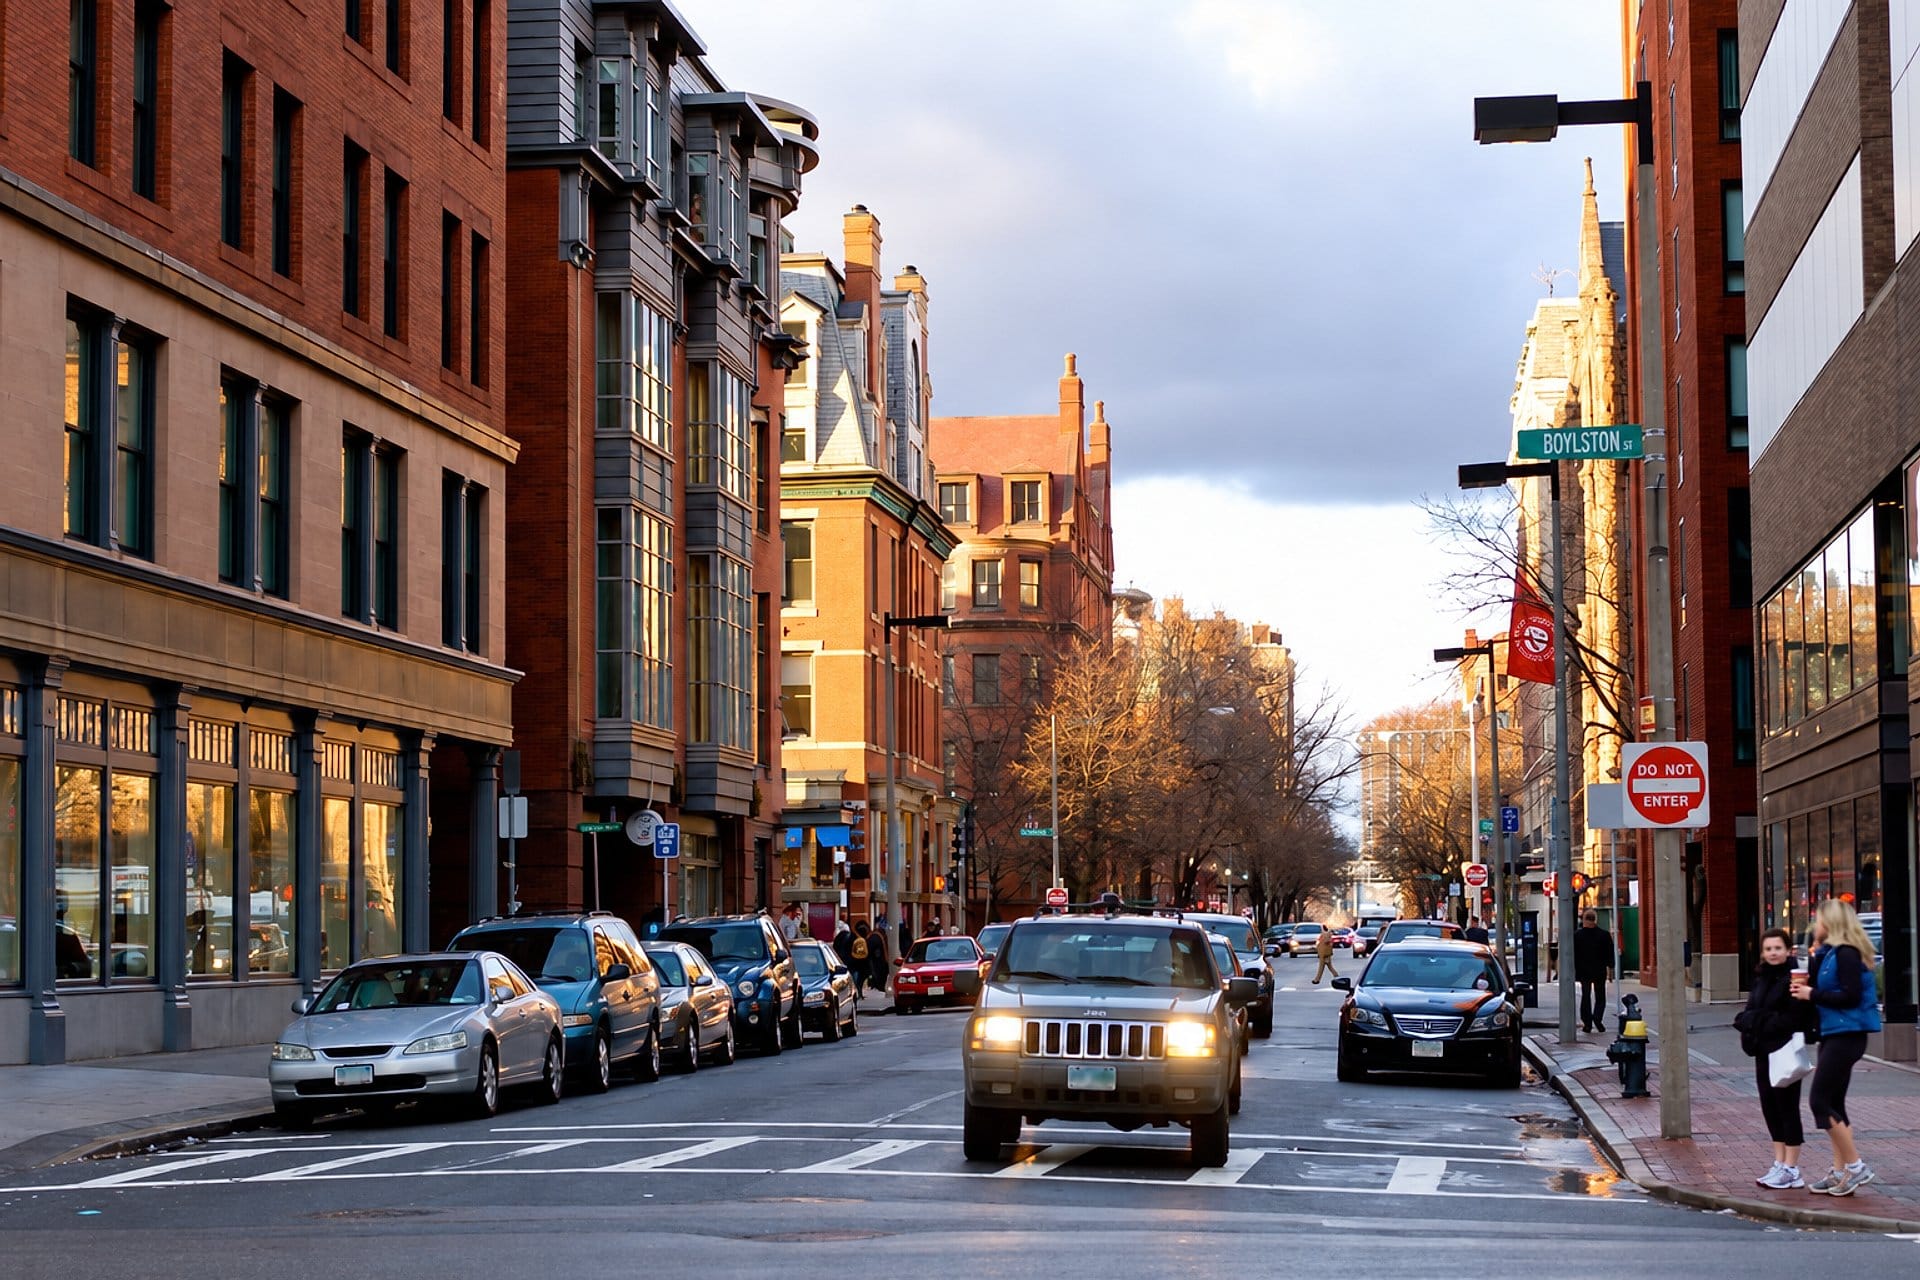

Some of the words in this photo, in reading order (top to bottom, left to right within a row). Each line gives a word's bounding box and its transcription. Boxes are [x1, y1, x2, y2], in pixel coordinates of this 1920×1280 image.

[1543, 430, 1620, 454] BOYLSTON
[1637, 764, 1658, 776] DO
[1665, 763, 1694, 776] NOT
[1643, 795, 1689, 807] ENTER
